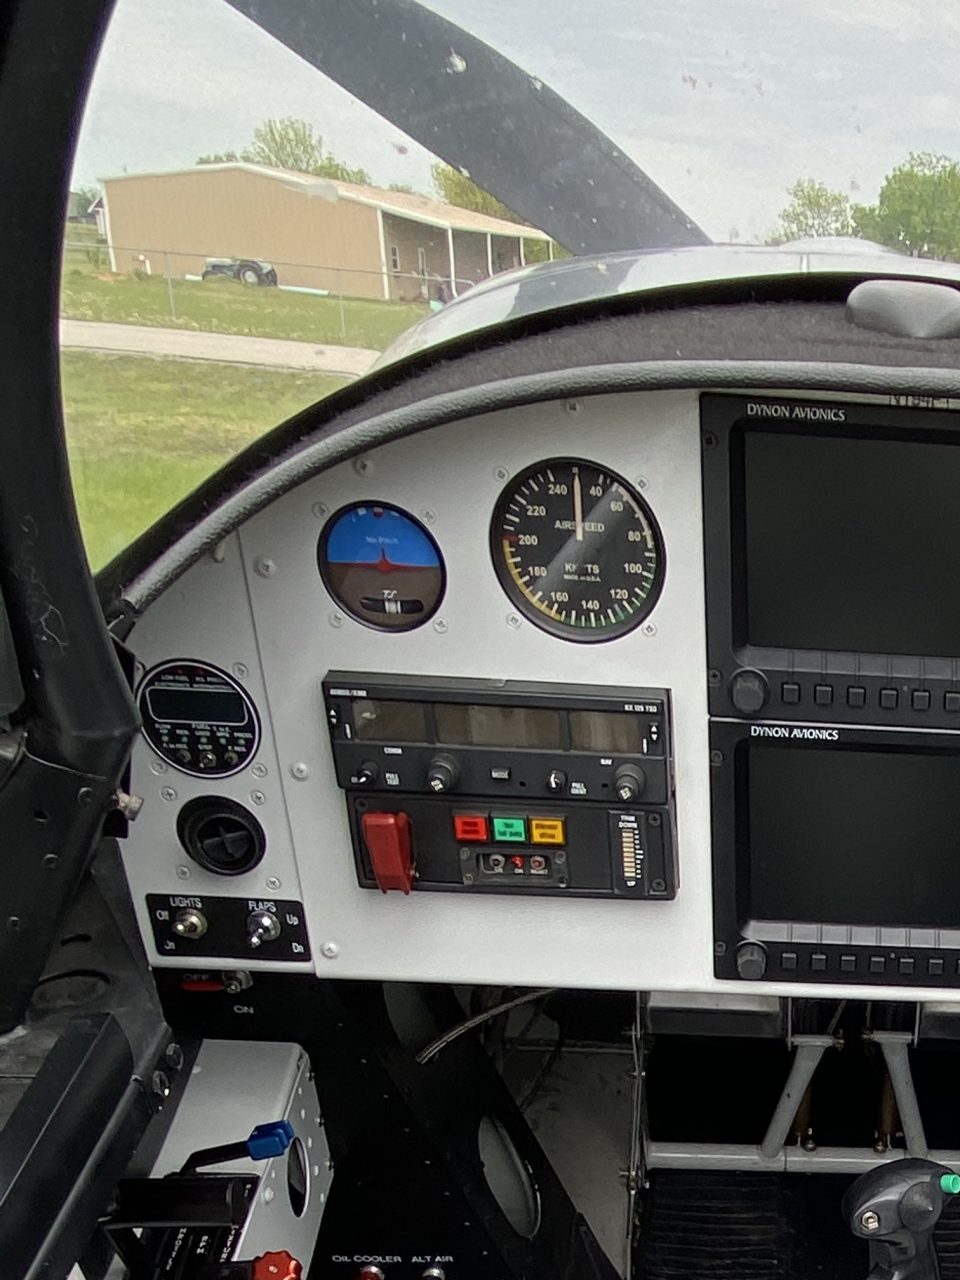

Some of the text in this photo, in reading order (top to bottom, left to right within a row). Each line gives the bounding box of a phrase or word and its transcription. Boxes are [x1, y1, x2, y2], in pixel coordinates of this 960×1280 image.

[747, 402, 845, 421] DYNON AVIONICS
[548, 484, 568, 496] 240
[589, 486, 602, 497] 40
[527, 505, 546, 517] 220
[610, 501, 623, 512] 60
[554, 519, 605, 532] AIREED
[518, 535, 538, 546] 200
[628, 531, 641, 542] 80
[564, 562, 600, 574] KNTS
[624, 563, 642, 574] 100
[610, 589, 628, 600] 120
[581, 600, 600, 611] 140
[750, 725, 839, 741] DYNON AVIONICS
[170, 897, 202, 908] LIGHTS
[248, 901, 276, 912] FLAPS
[286, 915, 299, 926] Up
[332, 1255, 402, 1263] OIL COOLER
[411, 1255, 454, 1263] ALT AIR
